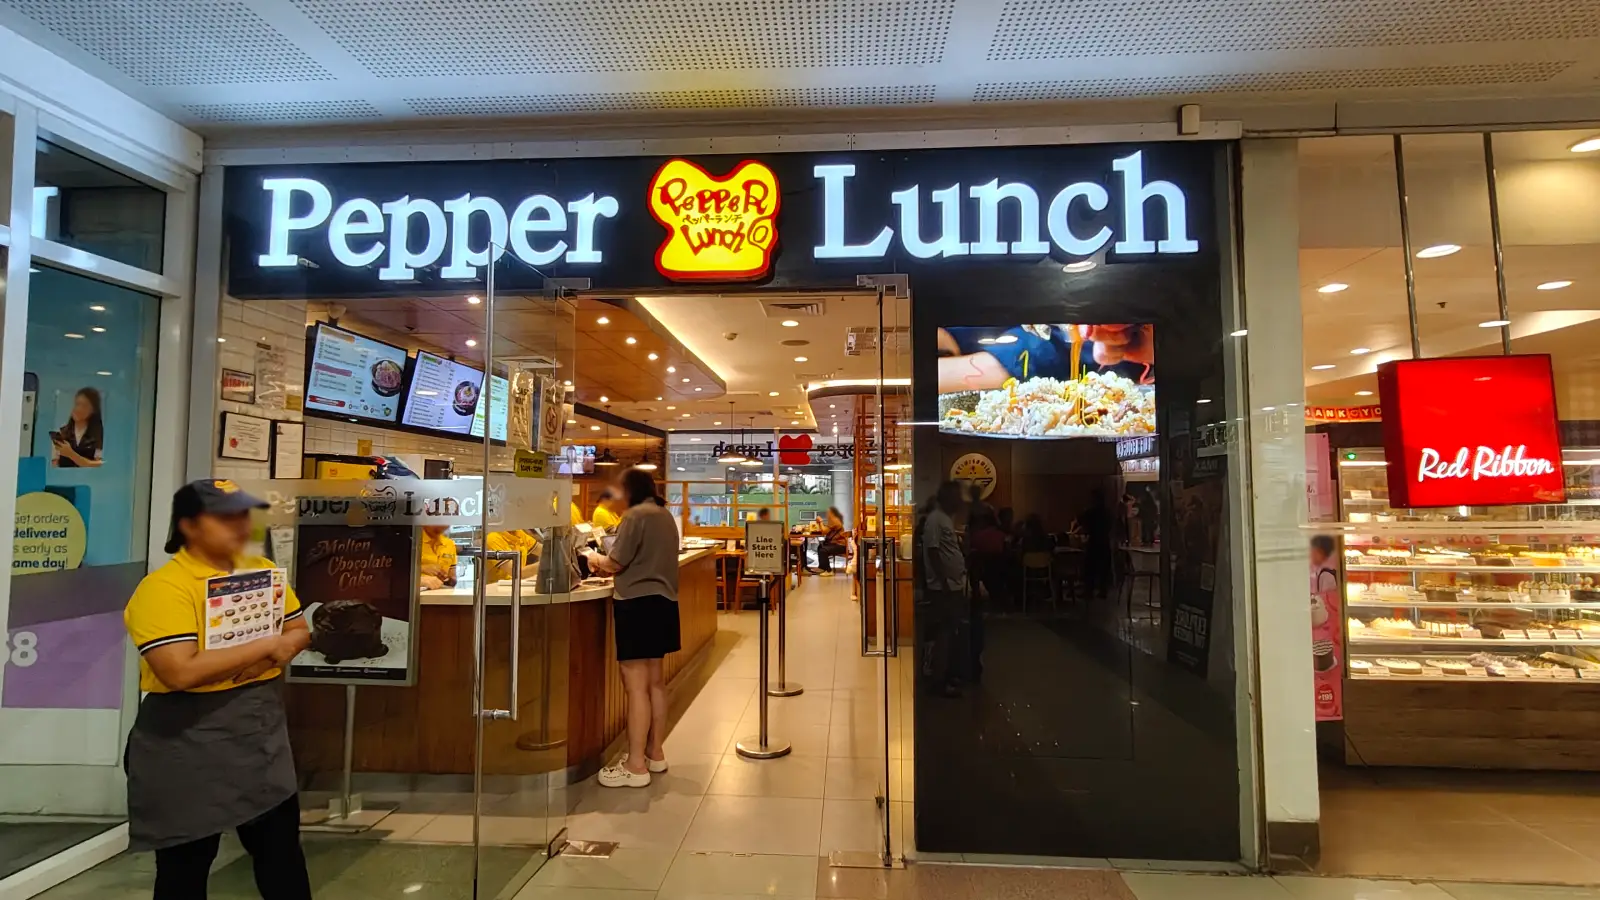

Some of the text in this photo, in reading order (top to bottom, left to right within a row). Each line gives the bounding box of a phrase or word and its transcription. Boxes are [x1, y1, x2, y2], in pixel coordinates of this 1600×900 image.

[259, 150, 1199, 281] Pepper Lunch
[1305, 407, 1382, 418] HANK YO
[1418, 444, 1555, 482] Red Ribbon
[33, 513, 70, 524] orders
[14, 527, 67, 538] delivered
[22, 542, 51, 555] early
[54, 545, 68, 553] as
[317, 538, 371, 554] Molten
[752, 543, 777, 551] Starts
[755, 551, 774, 559] Here
[12, 557, 69, 571] ame day!
[327, 553, 393, 577] Chocolate
[339, 570, 374, 591] Cake
[6, 631, 39, 668] 8
